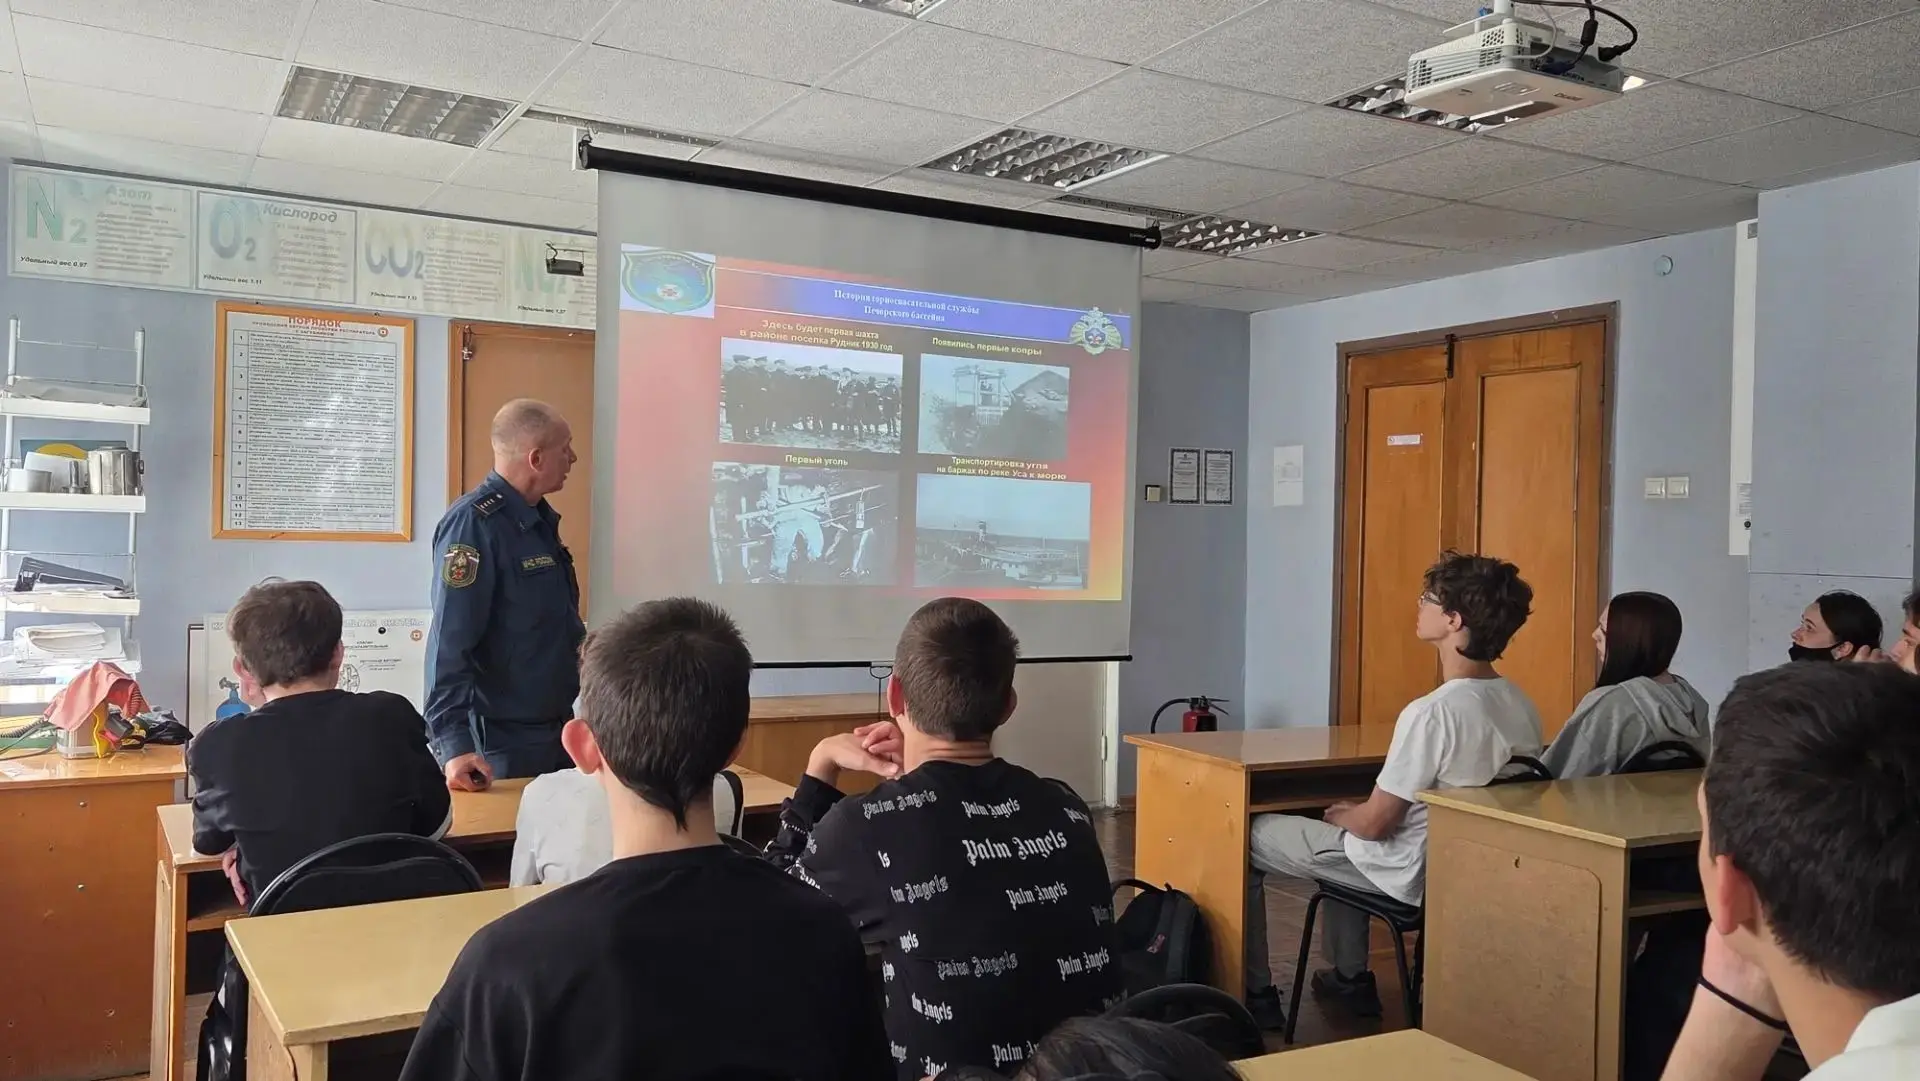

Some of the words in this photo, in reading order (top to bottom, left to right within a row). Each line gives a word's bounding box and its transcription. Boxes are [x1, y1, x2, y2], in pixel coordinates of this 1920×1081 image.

[105, 184, 152, 201] Азот
[263, 203, 338, 223] Кислород
[20, 256, 58, 265] Удельный
[834, 289, 871, 303] История
[871, 293, 946, 311] горноспасательной
[946, 303, 980, 314] службы
[288, 316, 342, 328] ПОРЯДОК
[864, 306, 910, 318] Печорского
[910, 310, 945, 322] бассейна
[750, 329, 789, 341] районе
[791, 334, 829, 345] поселка
[830, 334, 860, 347] Рудник
[861, 339, 879, 350] 1930
[879, 343, 893, 352] год
[761, 319, 794, 331] Здесь
[795, 322, 823, 334] будет
[824, 327, 854, 337] первая
[855, 331, 879, 340] шахта
[932, 336, 976, 350] Появились
[976, 343, 1010, 352] первые
[1011, 346, 1042, 356] копры
[785, 454, 823, 465] Первый
[823, 458, 849, 466] уголь
[951, 456, 1025, 470] Транспортировка
[1025, 461, 1049, 470] угля
[947, 466, 976, 475] баржах
[990, 470, 1010, 478] реке
[1012, 470, 1027, 478] Уса
[1036, 473, 1067, 481] морю
[862, 800, 896, 820] Palm
[896, 789, 938, 811] Angels
[961, 800, 990, 819] Palm
[987, 797, 1021, 819] Angels
[961, 838, 1012, 867] Palm
[1011, 828, 1068, 860] Angels
[905, 873, 949, 904] Angels
[1005, 887, 1036, 911] Palm
[1034, 880, 1068, 905] Angels
[935, 959, 970, 981] Palm
[970, 950, 1018, 978] Angels
[1056, 954, 1083, 982] Palm
[1082, 945, 1110, 974] Angels
[922, 998, 953, 1025] Angels
[991, 1042, 1024, 1069] Palm
